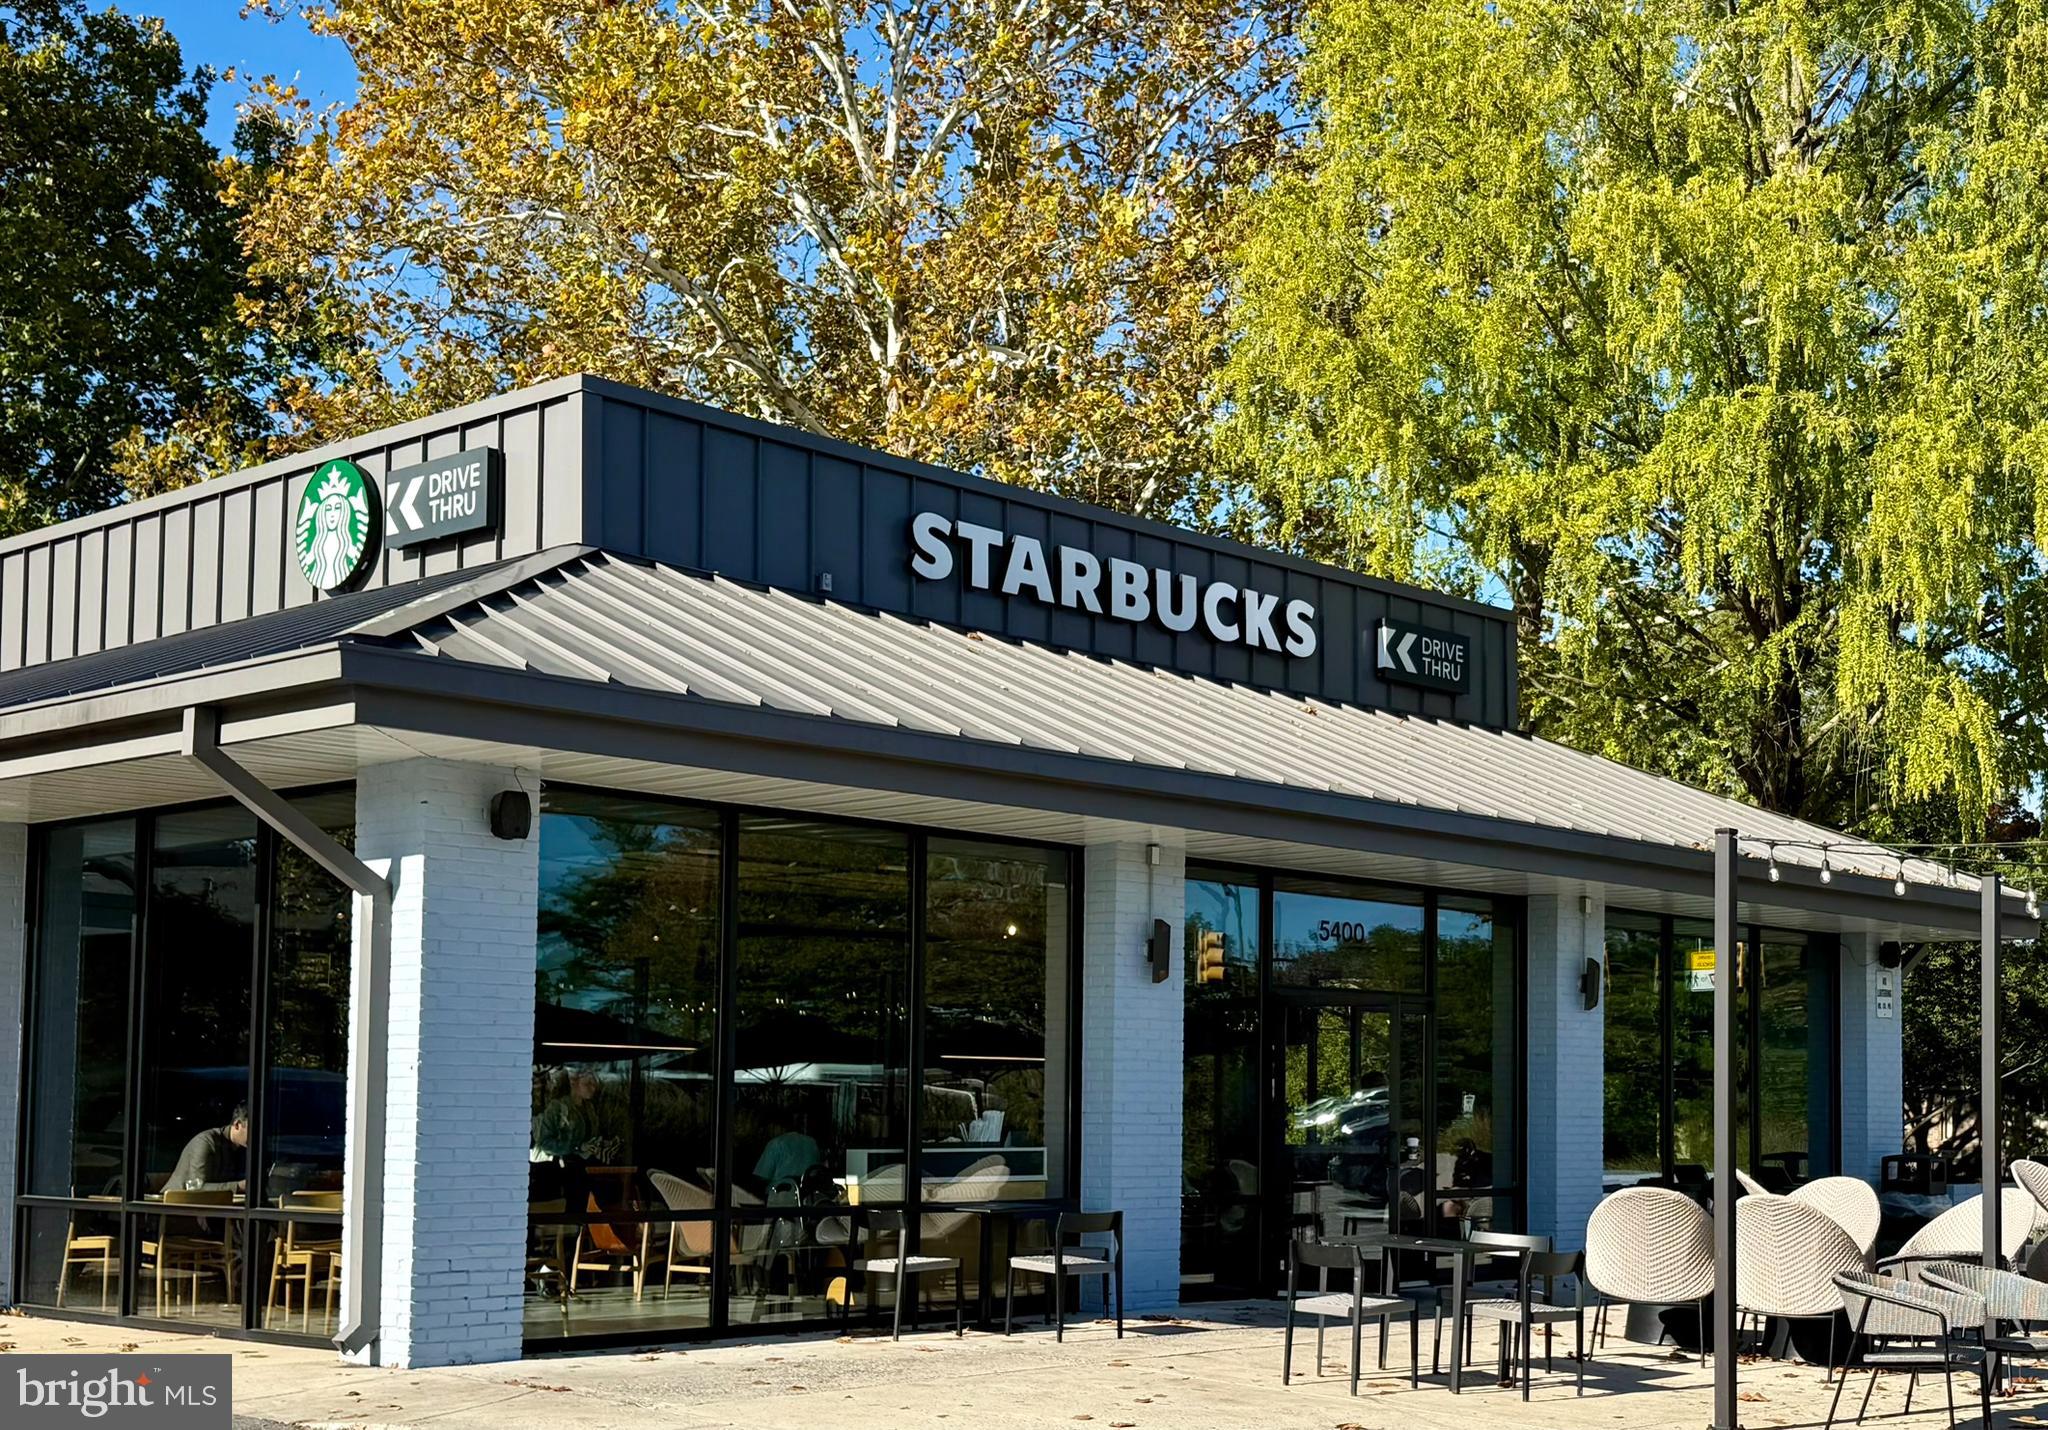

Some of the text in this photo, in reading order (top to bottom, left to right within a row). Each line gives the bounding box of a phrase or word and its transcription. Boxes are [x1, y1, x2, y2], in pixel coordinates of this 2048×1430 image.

[429, 462, 481, 498] DRIVE
[429, 490, 477, 524] THRU
[911, 510, 1318, 659] STARBUCKS
[1421, 636, 1465, 663] DRIVE
[1421, 656, 1462, 682] THRU
[1319, 919, 1365, 944] 5400
